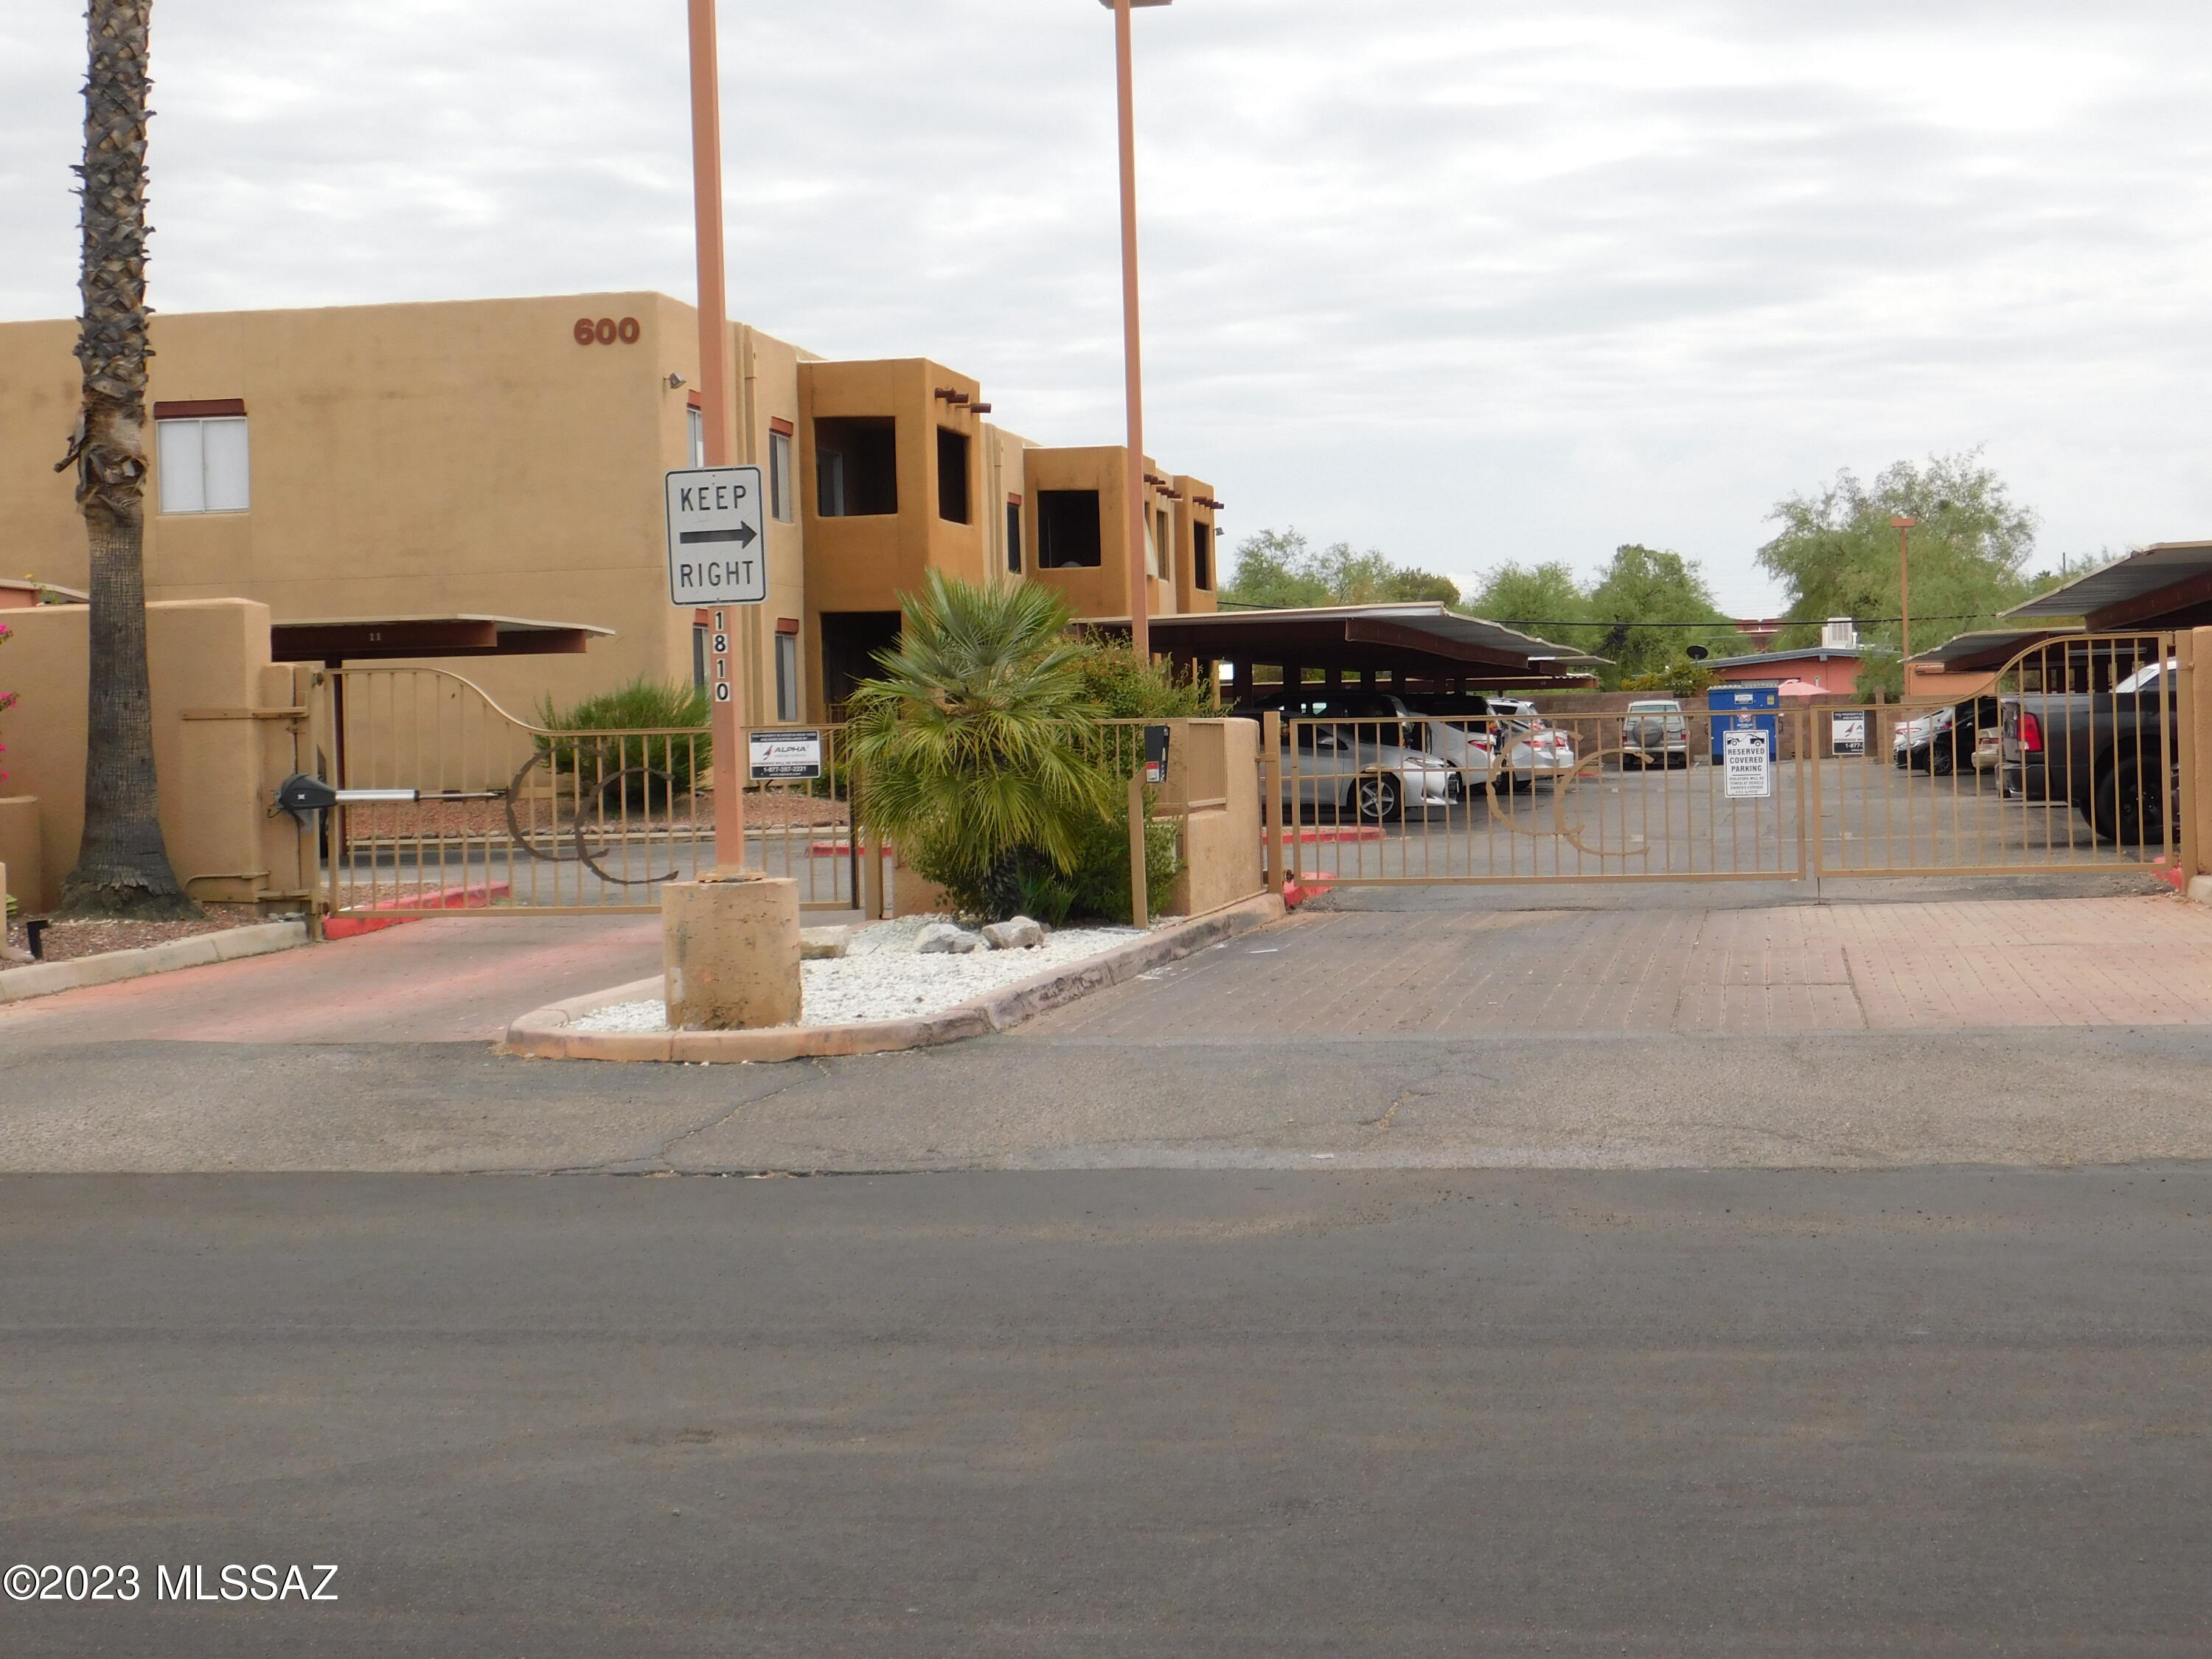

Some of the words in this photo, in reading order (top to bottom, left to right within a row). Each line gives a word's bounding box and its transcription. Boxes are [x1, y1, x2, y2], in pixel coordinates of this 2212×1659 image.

[574, 317, 640, 345] 600
[680, 485, 747, 512] KEEP
[680, 560, 754, 588] RIGHT
[714, 611, 729, 701] 1810
